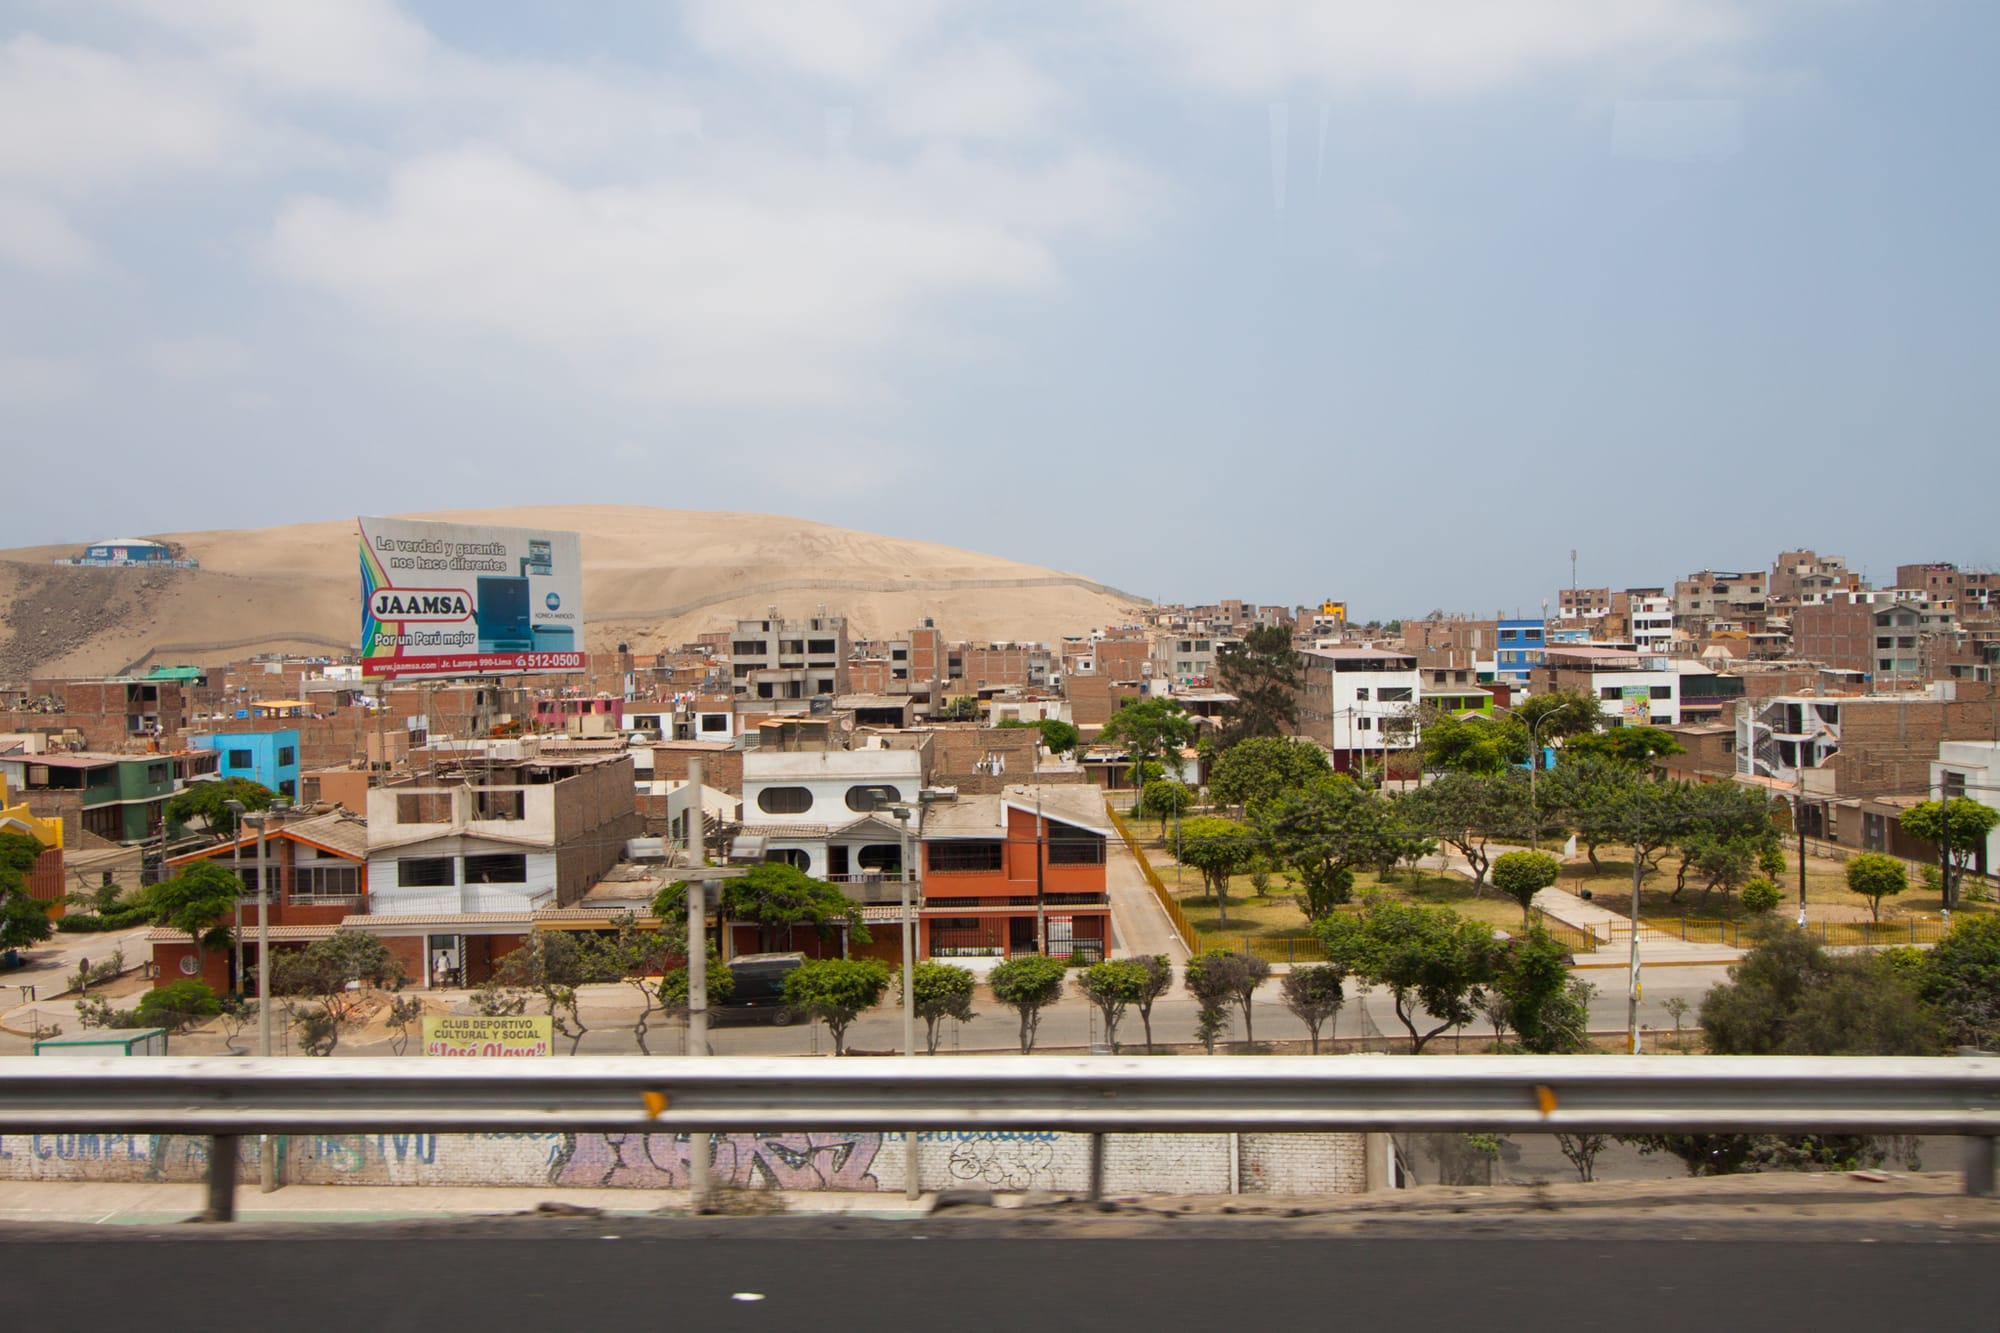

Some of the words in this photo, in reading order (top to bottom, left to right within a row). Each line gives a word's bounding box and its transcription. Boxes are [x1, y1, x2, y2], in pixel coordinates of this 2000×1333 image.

[376, 536, 394, 551] La
[397, 539, 443, 553] verdad
[445, 544, 453, 557] y
[456, 542, 506, 556] garantía
[391, 557, 414, 568] nos
[417, 556, 447, 570] hace
[449, 557, 507, 571] diferentes
[376, 596, 467, 615] JAAMSA
[374, 633, 396, 646] Por
[398, 634, 413, 645] un
[415, 631, 441, 645] Perú
[443, 631, 475, 647] mejor
[373, 662, 437, 672] www.jaamsa.com
[441, 660, 451, 669] Jr.
[453, 659, 478, 669] Lampa
[480, 658, 513, 667] 990-Lima
[528, 654, 580, 667] 512-0500
[442, 1020, 470, 1029] CLUB
[473, 1020, 533, 1029] DEPORTIVO
[434, 1030, 489, 1039] CULTURAL
[492, 1030, 499, 1039] Y
[502, 1030, 541, 1039] SOCIAL
